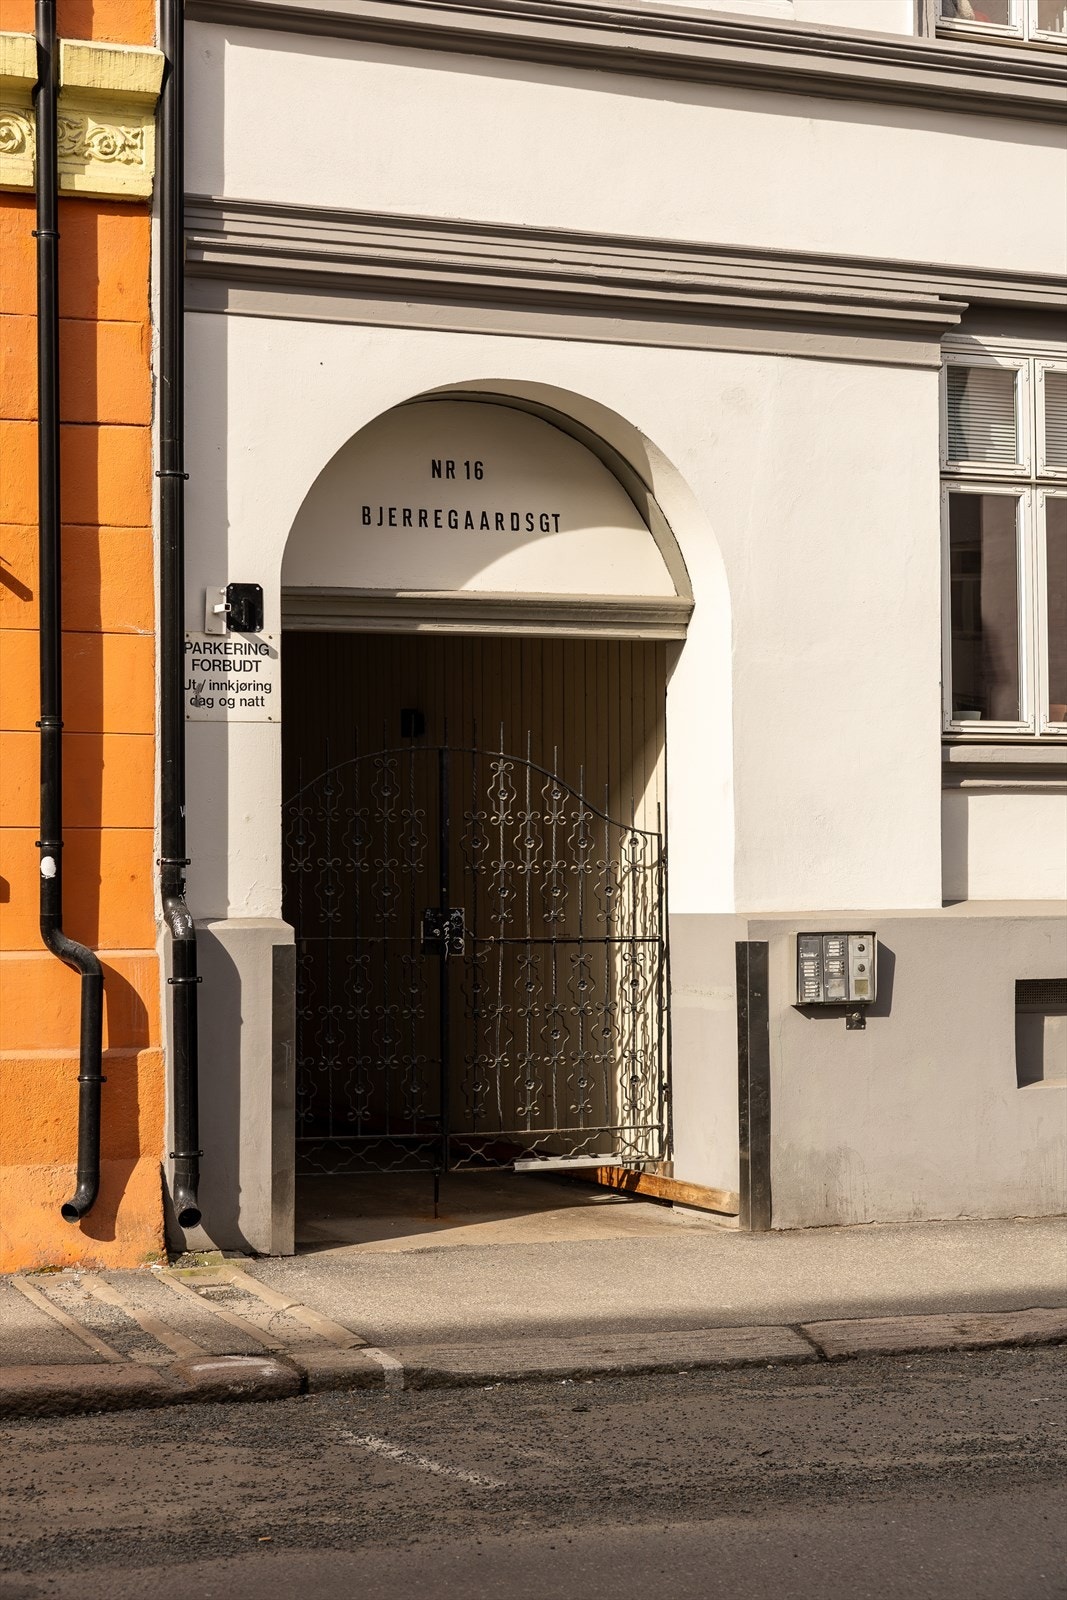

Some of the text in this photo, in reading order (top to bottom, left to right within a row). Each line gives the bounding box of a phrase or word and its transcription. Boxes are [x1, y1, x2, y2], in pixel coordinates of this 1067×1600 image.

[431, 459, 484, 480] NR 16
[362, 506, 560, 533] BJERREGAARDSGT
[184, 642, 270, 656] PARKERING
[192, 659, 262, 673] FORBUDT
[209, 680, 272, 694] innkjøring
[190, 696, 265, 709] dag og natt
